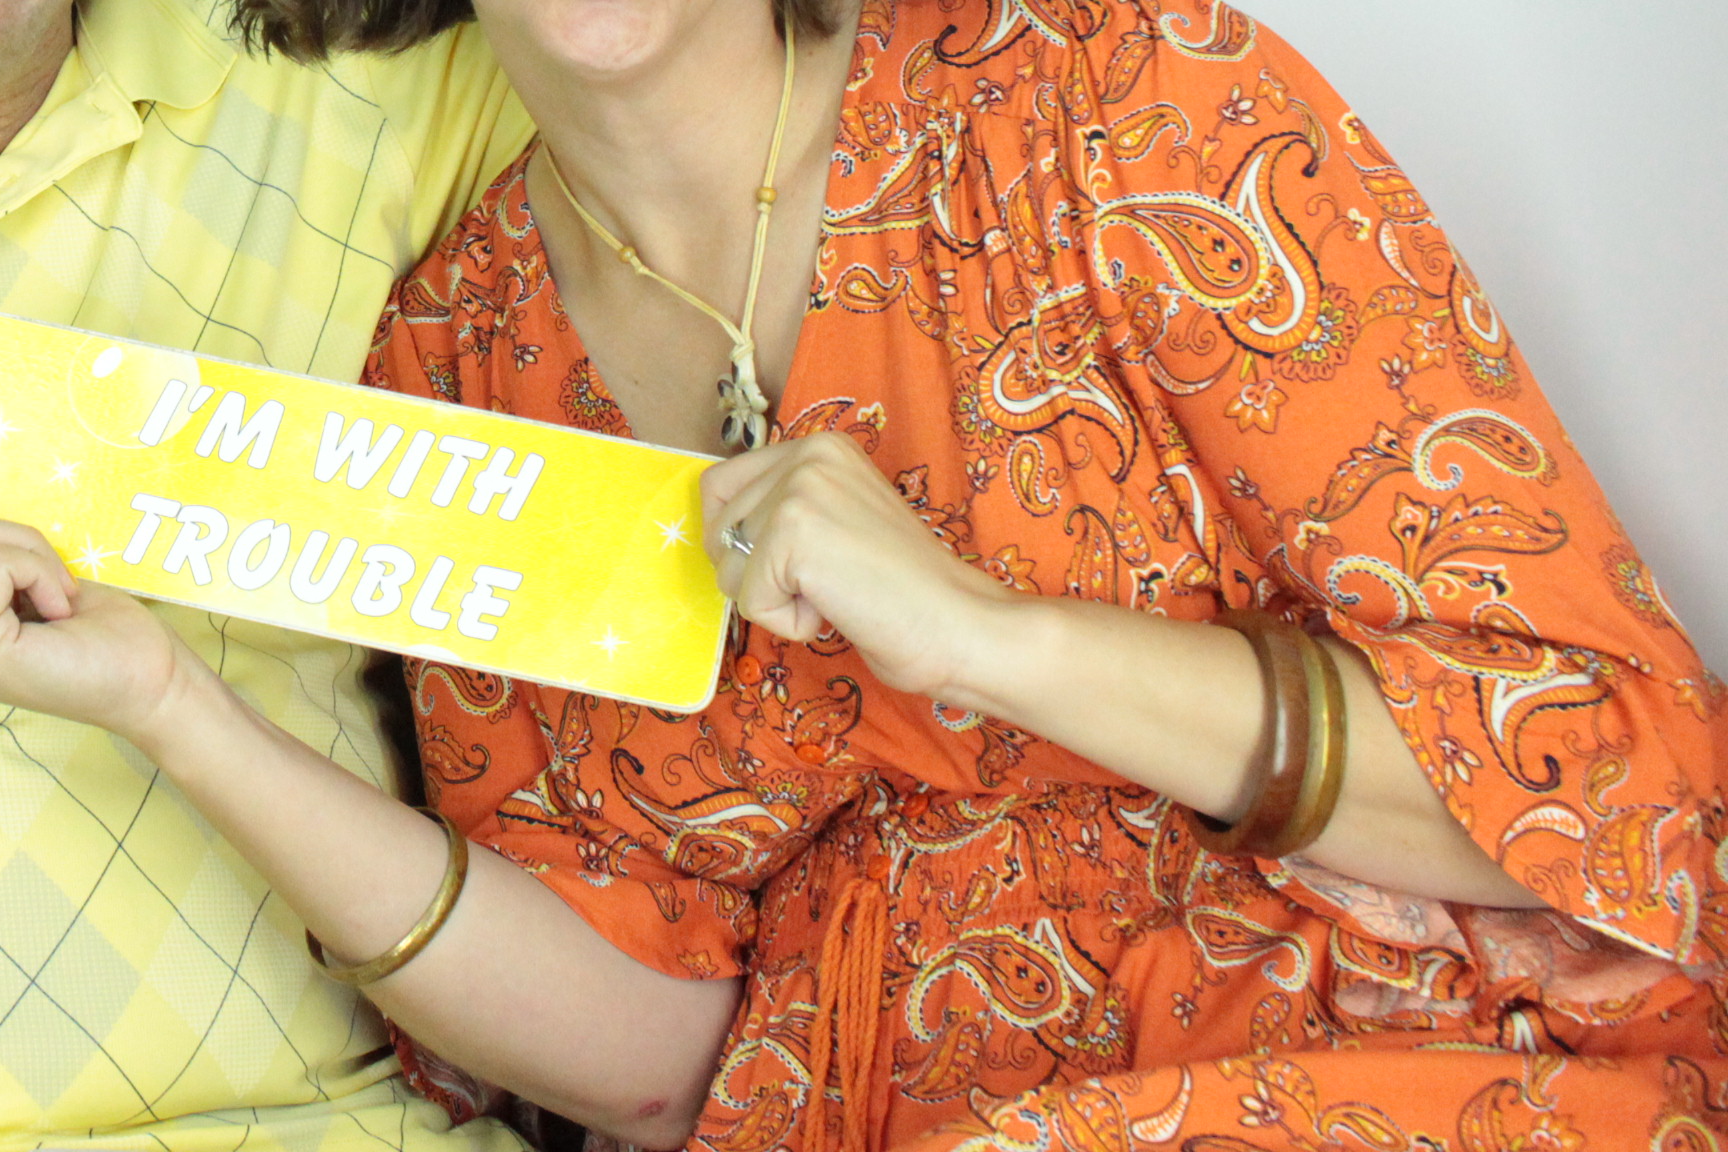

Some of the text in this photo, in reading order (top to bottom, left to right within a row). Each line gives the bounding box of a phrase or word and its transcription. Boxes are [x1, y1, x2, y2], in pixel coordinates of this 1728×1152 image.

[138, 378, 546, 522] I'M WITH
[122, 492, 524, 641] TROUBLE
